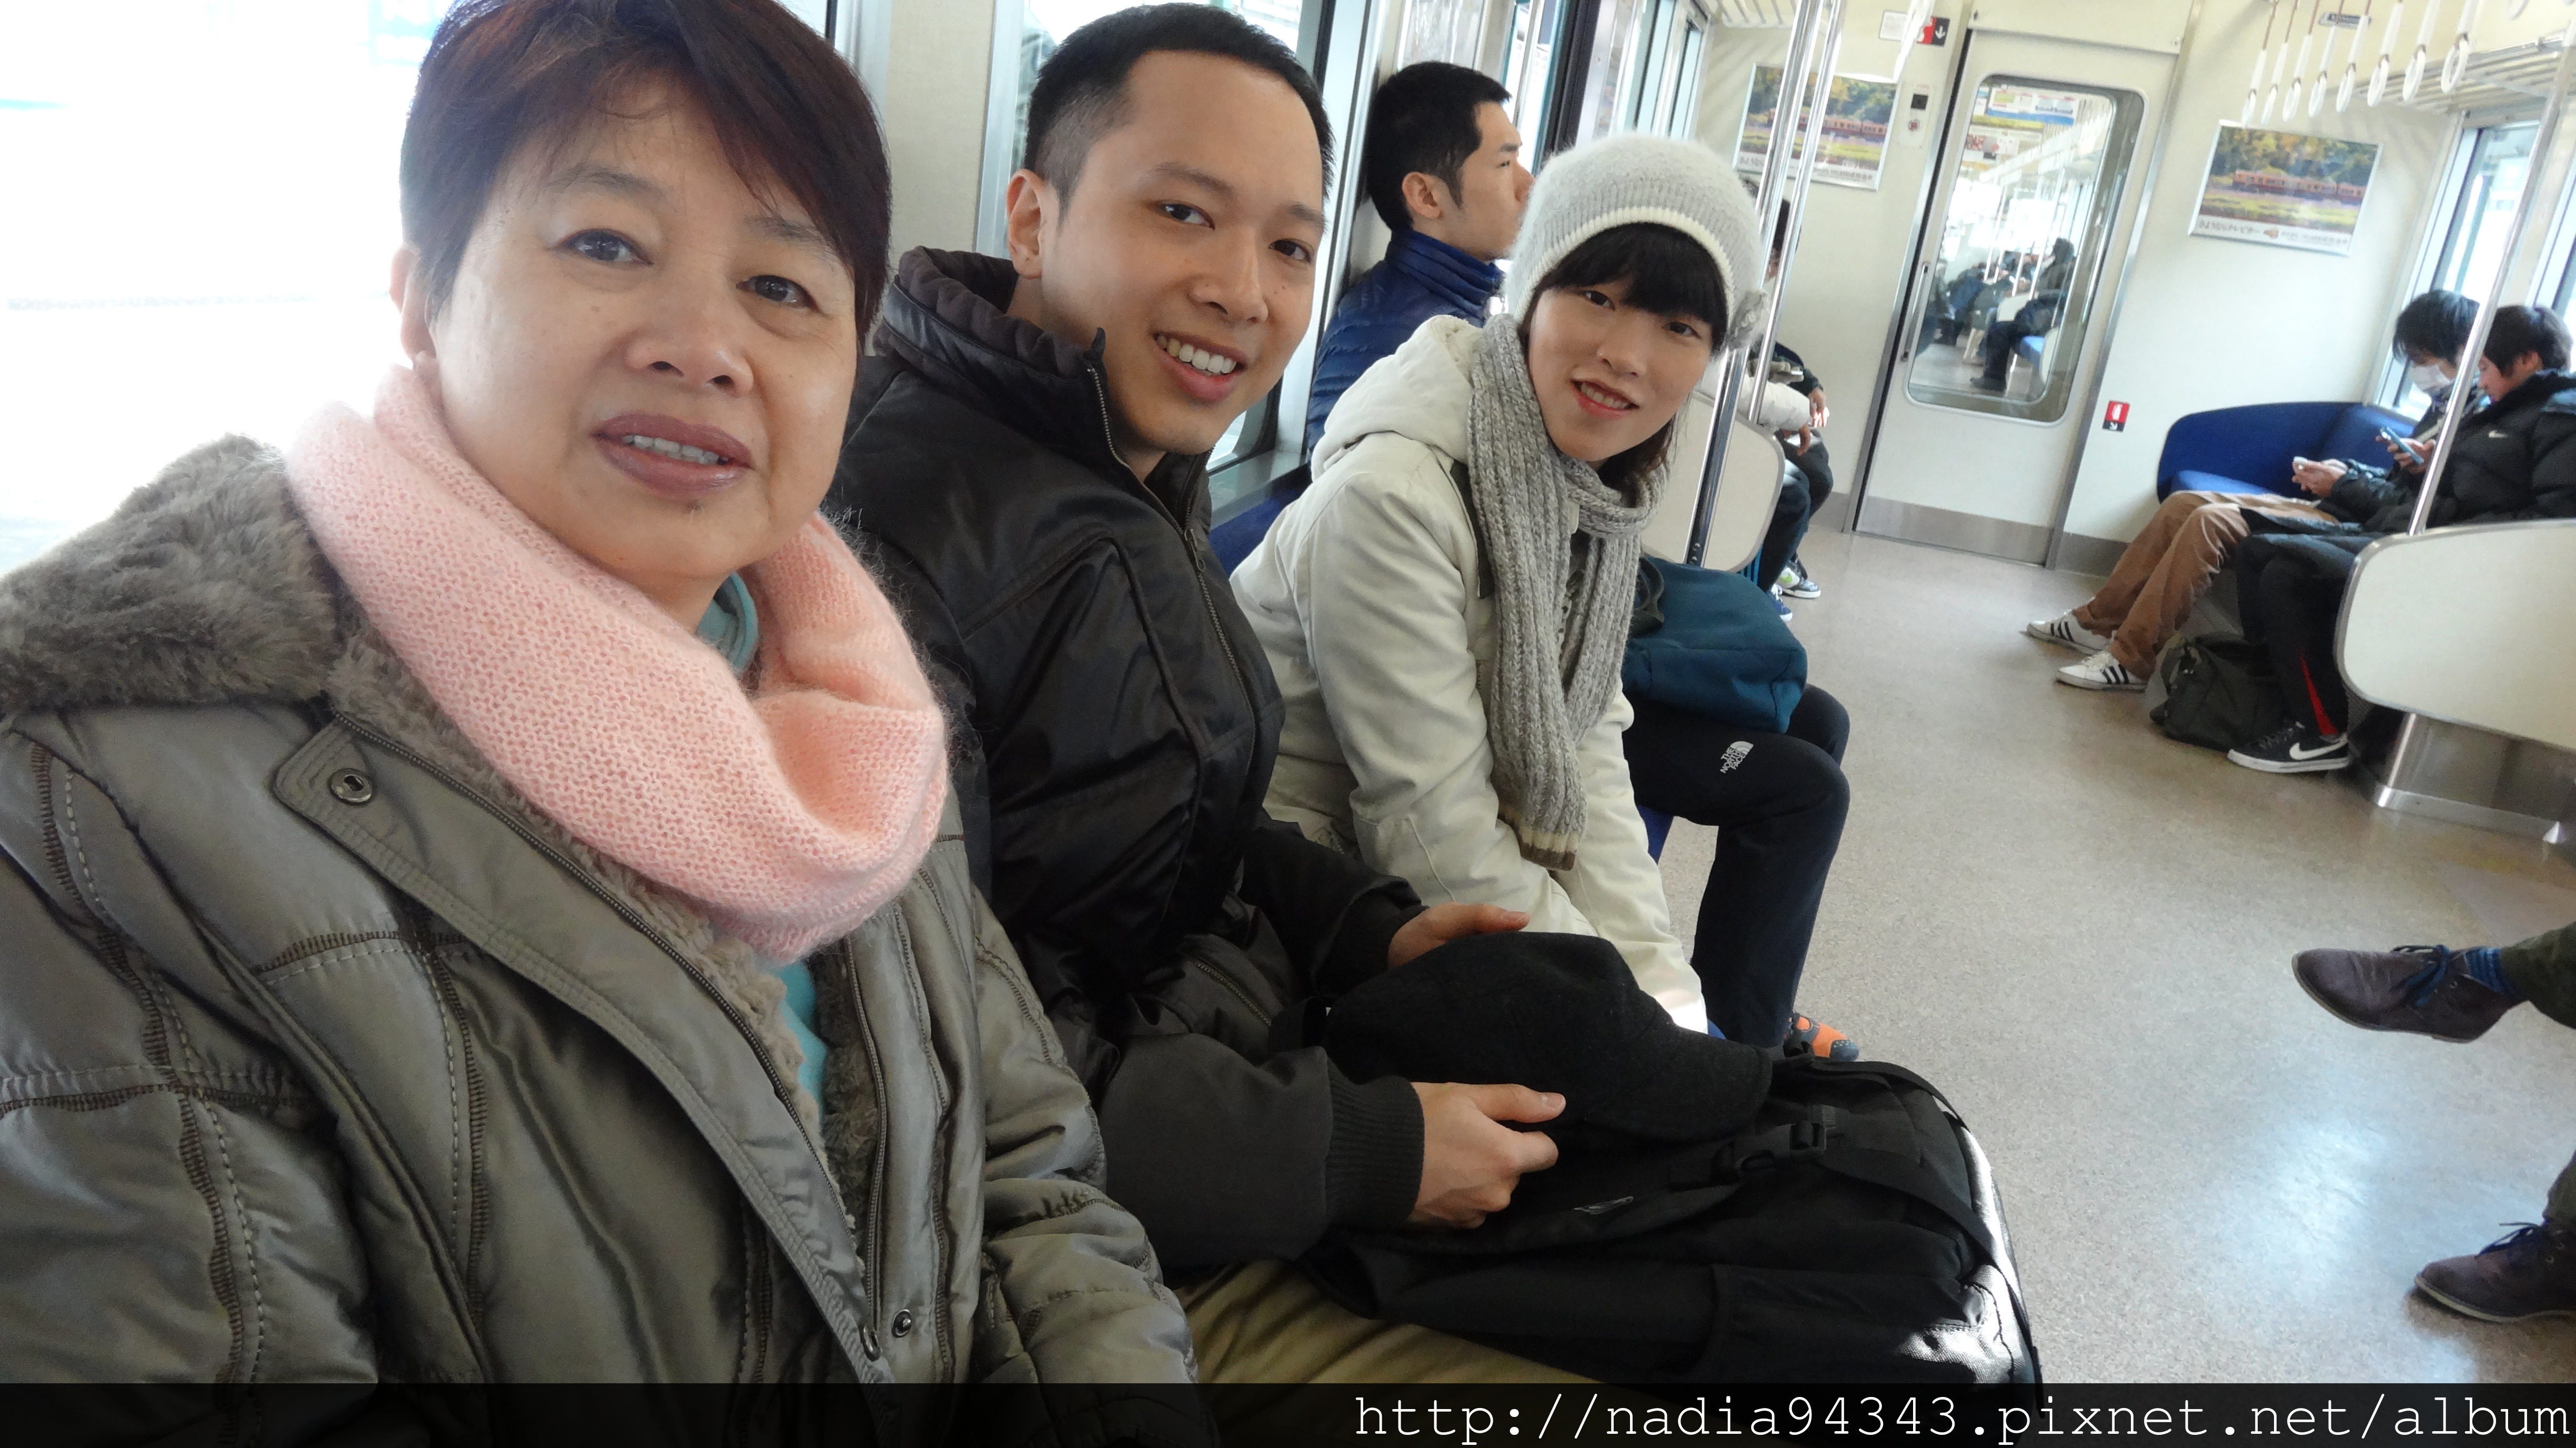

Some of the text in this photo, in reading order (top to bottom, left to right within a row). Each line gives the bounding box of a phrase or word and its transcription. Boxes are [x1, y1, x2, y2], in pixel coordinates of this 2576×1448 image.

[1720, 747, 1734, 760] THE
[1720, 749, 1741, 773] NORTH
[1730, 753, 1746, 770] FACE
